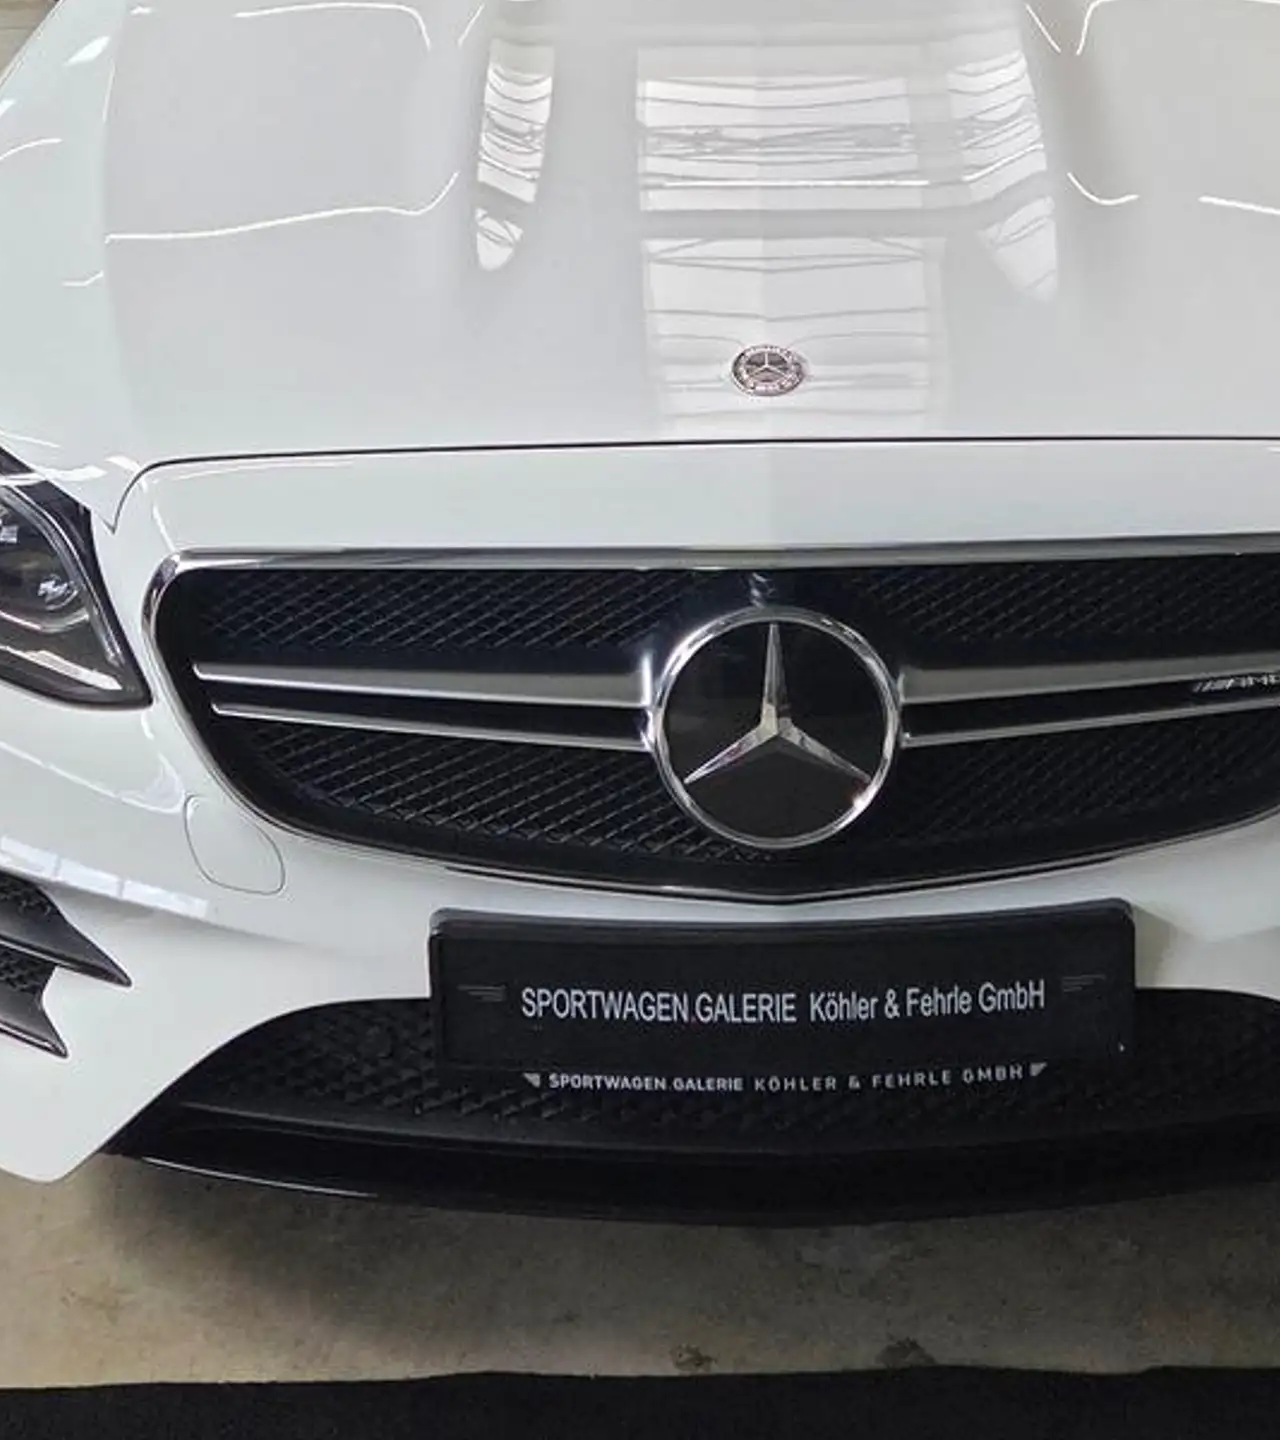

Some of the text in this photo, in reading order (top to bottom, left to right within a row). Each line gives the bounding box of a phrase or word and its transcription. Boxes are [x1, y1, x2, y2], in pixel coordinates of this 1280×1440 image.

[809, 991, 878, 1022] Köhler
[884, 988, 900, 1019] &
[906, 984, 972, 1017] Fehrle
[978, 979, 1045, 1013] GmbH
[754, 1073, 837, 1092] KÖHLER
[872, 1069, 952, 1088] FEHRLE
[962, 1064, 1023, 1083] GMBH
